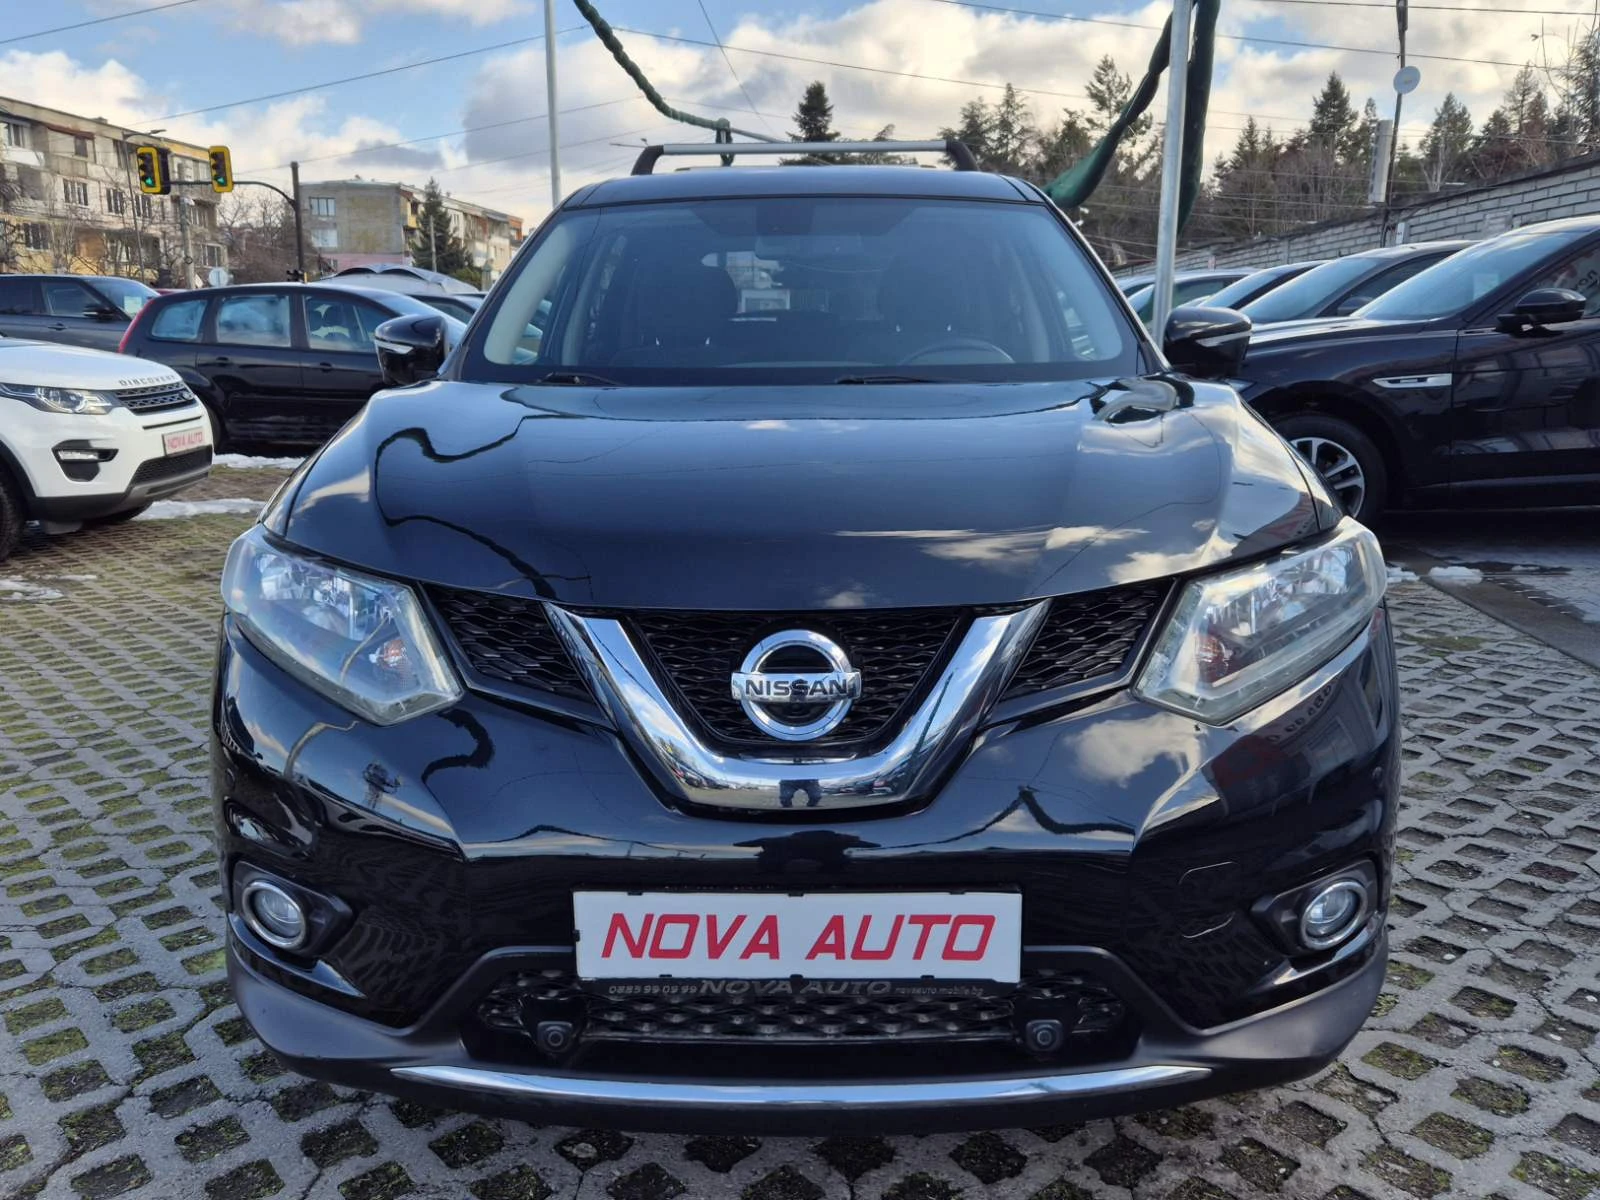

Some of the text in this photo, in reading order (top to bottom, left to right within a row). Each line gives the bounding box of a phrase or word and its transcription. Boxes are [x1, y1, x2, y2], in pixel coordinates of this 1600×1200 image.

[745, 679, 847, 696] NISSAN
[602, 913, 996, 961] NOVA AUTO
[700, 980, 792, 994] NOVA
[801, 981, 891, 994] AUTO
